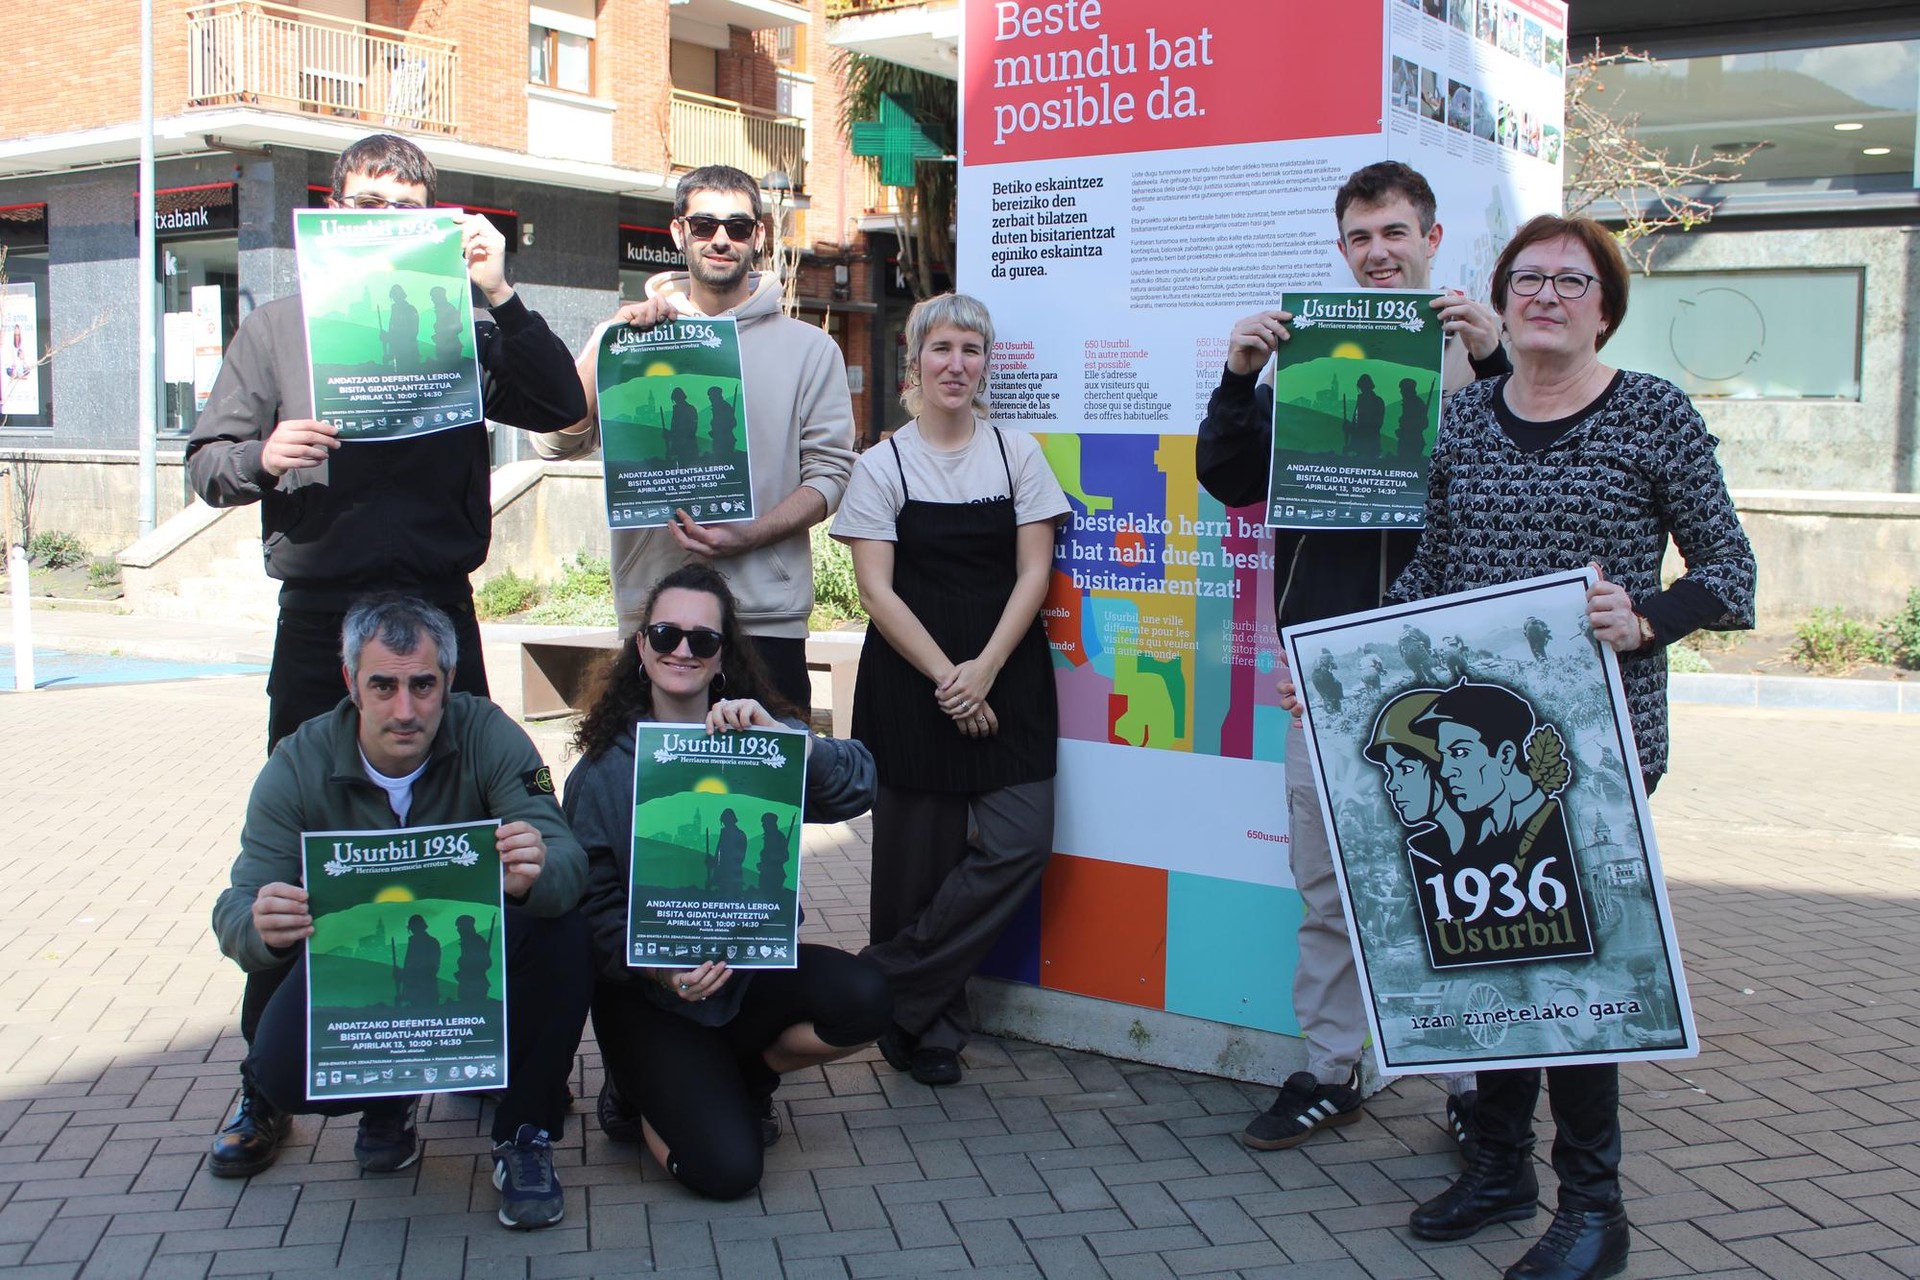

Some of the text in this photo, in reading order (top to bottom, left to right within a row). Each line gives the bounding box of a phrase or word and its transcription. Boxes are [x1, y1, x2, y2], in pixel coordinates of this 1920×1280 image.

[995, 0, 1101, 40] Beste
[994, 28, 1213, 88] mundu bat
[994, 76, 1205, 145] posible da.
[993, 177, 1103, 195] Betiko eskaintzez
[993, 194, 1075, 211] bereiziko den
[155, 206, 208, 229] txabank
[992, 212, 1087, 228] zerbait bilatzen
[992, 226, 1115, 244] duten bisitarientzat
[627, 242, 688, 264] kutxaban
[992, 244, 1102, 264] eginiko eskaintza
[992, 265, 1047, 279] da gurea.
[1303, 299, 1417, 319] Usurbil 1936
[617, 324, 714, 344] Usurbil 1936
[1006, 342, 1034, 350] Usurbil.
[1101, 339, 1130, 348] Usurbil.
[1120, 350, 1148, 358] monde
[1000, 362, 1028, 371] posible.
[1097, 360, 1132, 370] possible.
[328, 372, 461, 385] ANDATZAKO DEFENTSA LERROA
[1085, 370, 1136, 378] Elle s'adresse
[368, 382, 451, 393] GIDATU-ANTZEZTUA
[1101, 381, 1134, 389] visiteurs
[1136, 381, 1149, 391] qui
[1019, 391, 1034, 400] algo
[1084, 391, 1158, 401] cherchent quelque
[1109, 401, 1121, 412] qui
[1134, 401, 1171, 412] distingue
[1084, 411, 1169, 420] des offres habituelles.
[665, 468, 703, 476] DEFENTSA
[1287, 464, 1418, 478] ANDATZAKO DEFENTSA LERROA
[653, 474, 726, 485] GIDATU-ANTZEZTUA
[1296, 474, 1407, 487] BISITA GIDATU-ANTZEZTUA
[1073, 511, 1272, 539] bestelako herri bat
[1072, 541, 1103, 562] bat
[1109, 542, 1155, 566] nahi
[1162, 542, 1215, 567] duen
[1072, 568, 1241, 598] bisitariarentzat!
[1143, 615, 1184, 625] une ville
[1152, 627, 1190, 638] pour les
[1222, 630, 1244, 642] kind
[1104, 635, 1199, 650] visiteurs qui veulent
[1222, 643, 1258, 654] visitors
[1118, 648, 1180, 659] autre monde!
[1222, 655, 1266, 667] different
[663, 734, 779, 755] Usurbil 1936
[1247, 830, 1288, 843] 650usurb
[333, 833, 470, 863] Usurbil 1936
[391, 863, 422, 872] memoria
[1425, 856, 1568, 923] 1936
[686, 911, 769, 920] GIDATU-ANTZEZTUA
[1435, 907, 1576, 955] Usurbil
[1411, 1000, 1641, 1029] izan zinetelako gara
[328, 1017, 485, 1031] ANDATZAKO DEFENTSA LERROA
[340, 1028, 473, 1041] BISITA GIDATU-ANTZEZTUA
[352, 1041, 392, 1050] APIRILAK
[394, 1041, 405, 1049] 13,
